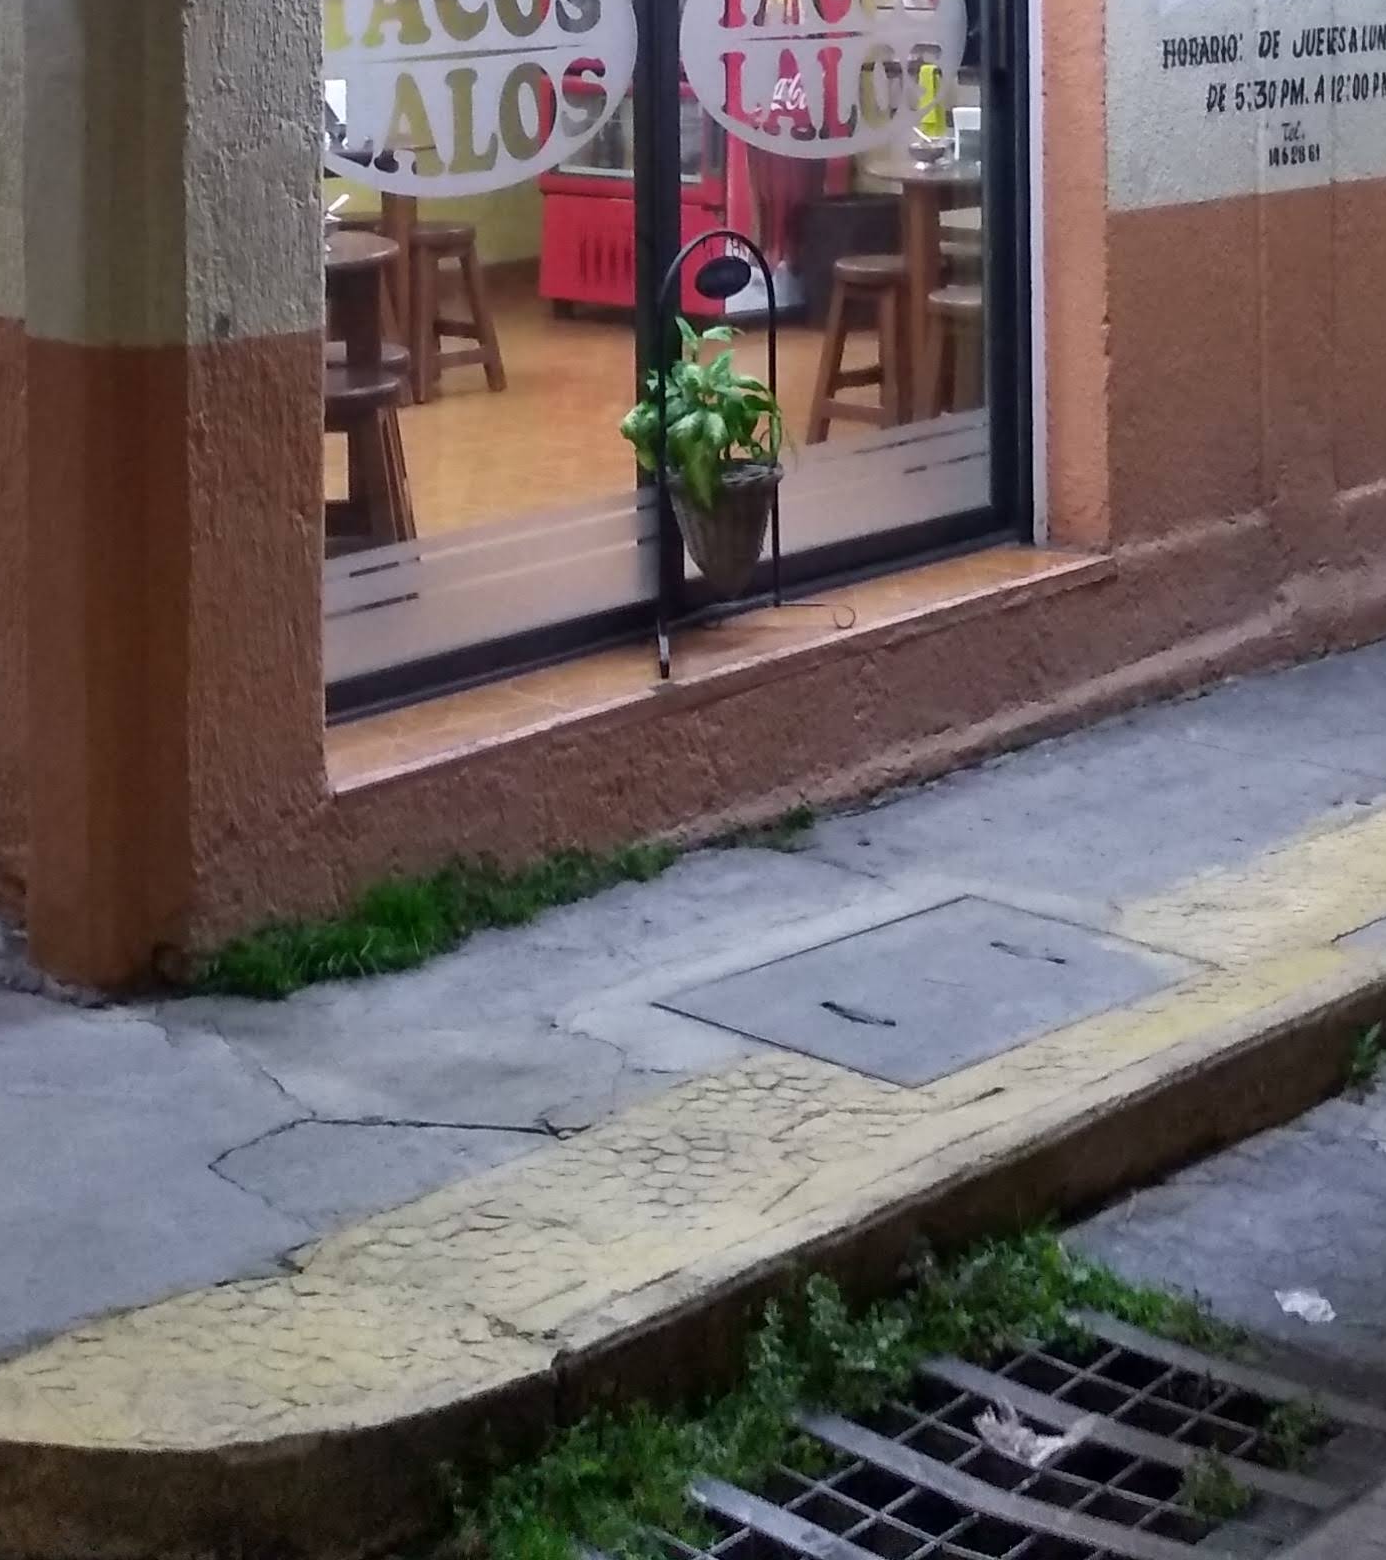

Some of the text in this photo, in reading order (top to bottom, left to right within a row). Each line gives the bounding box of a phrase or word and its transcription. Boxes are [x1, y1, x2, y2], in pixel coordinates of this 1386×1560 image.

[1258, 29, 1281, 60] DE
[1347, 26, 1358, 53] A
[718, 42, 943, 142] LALOS
[1206, 81, 1227, 113] DE
[1234, 80, 1276, 112] 5:30
[1314, 74, 1325, 104] A
[1331, 72, 1369, 104] 12:00
